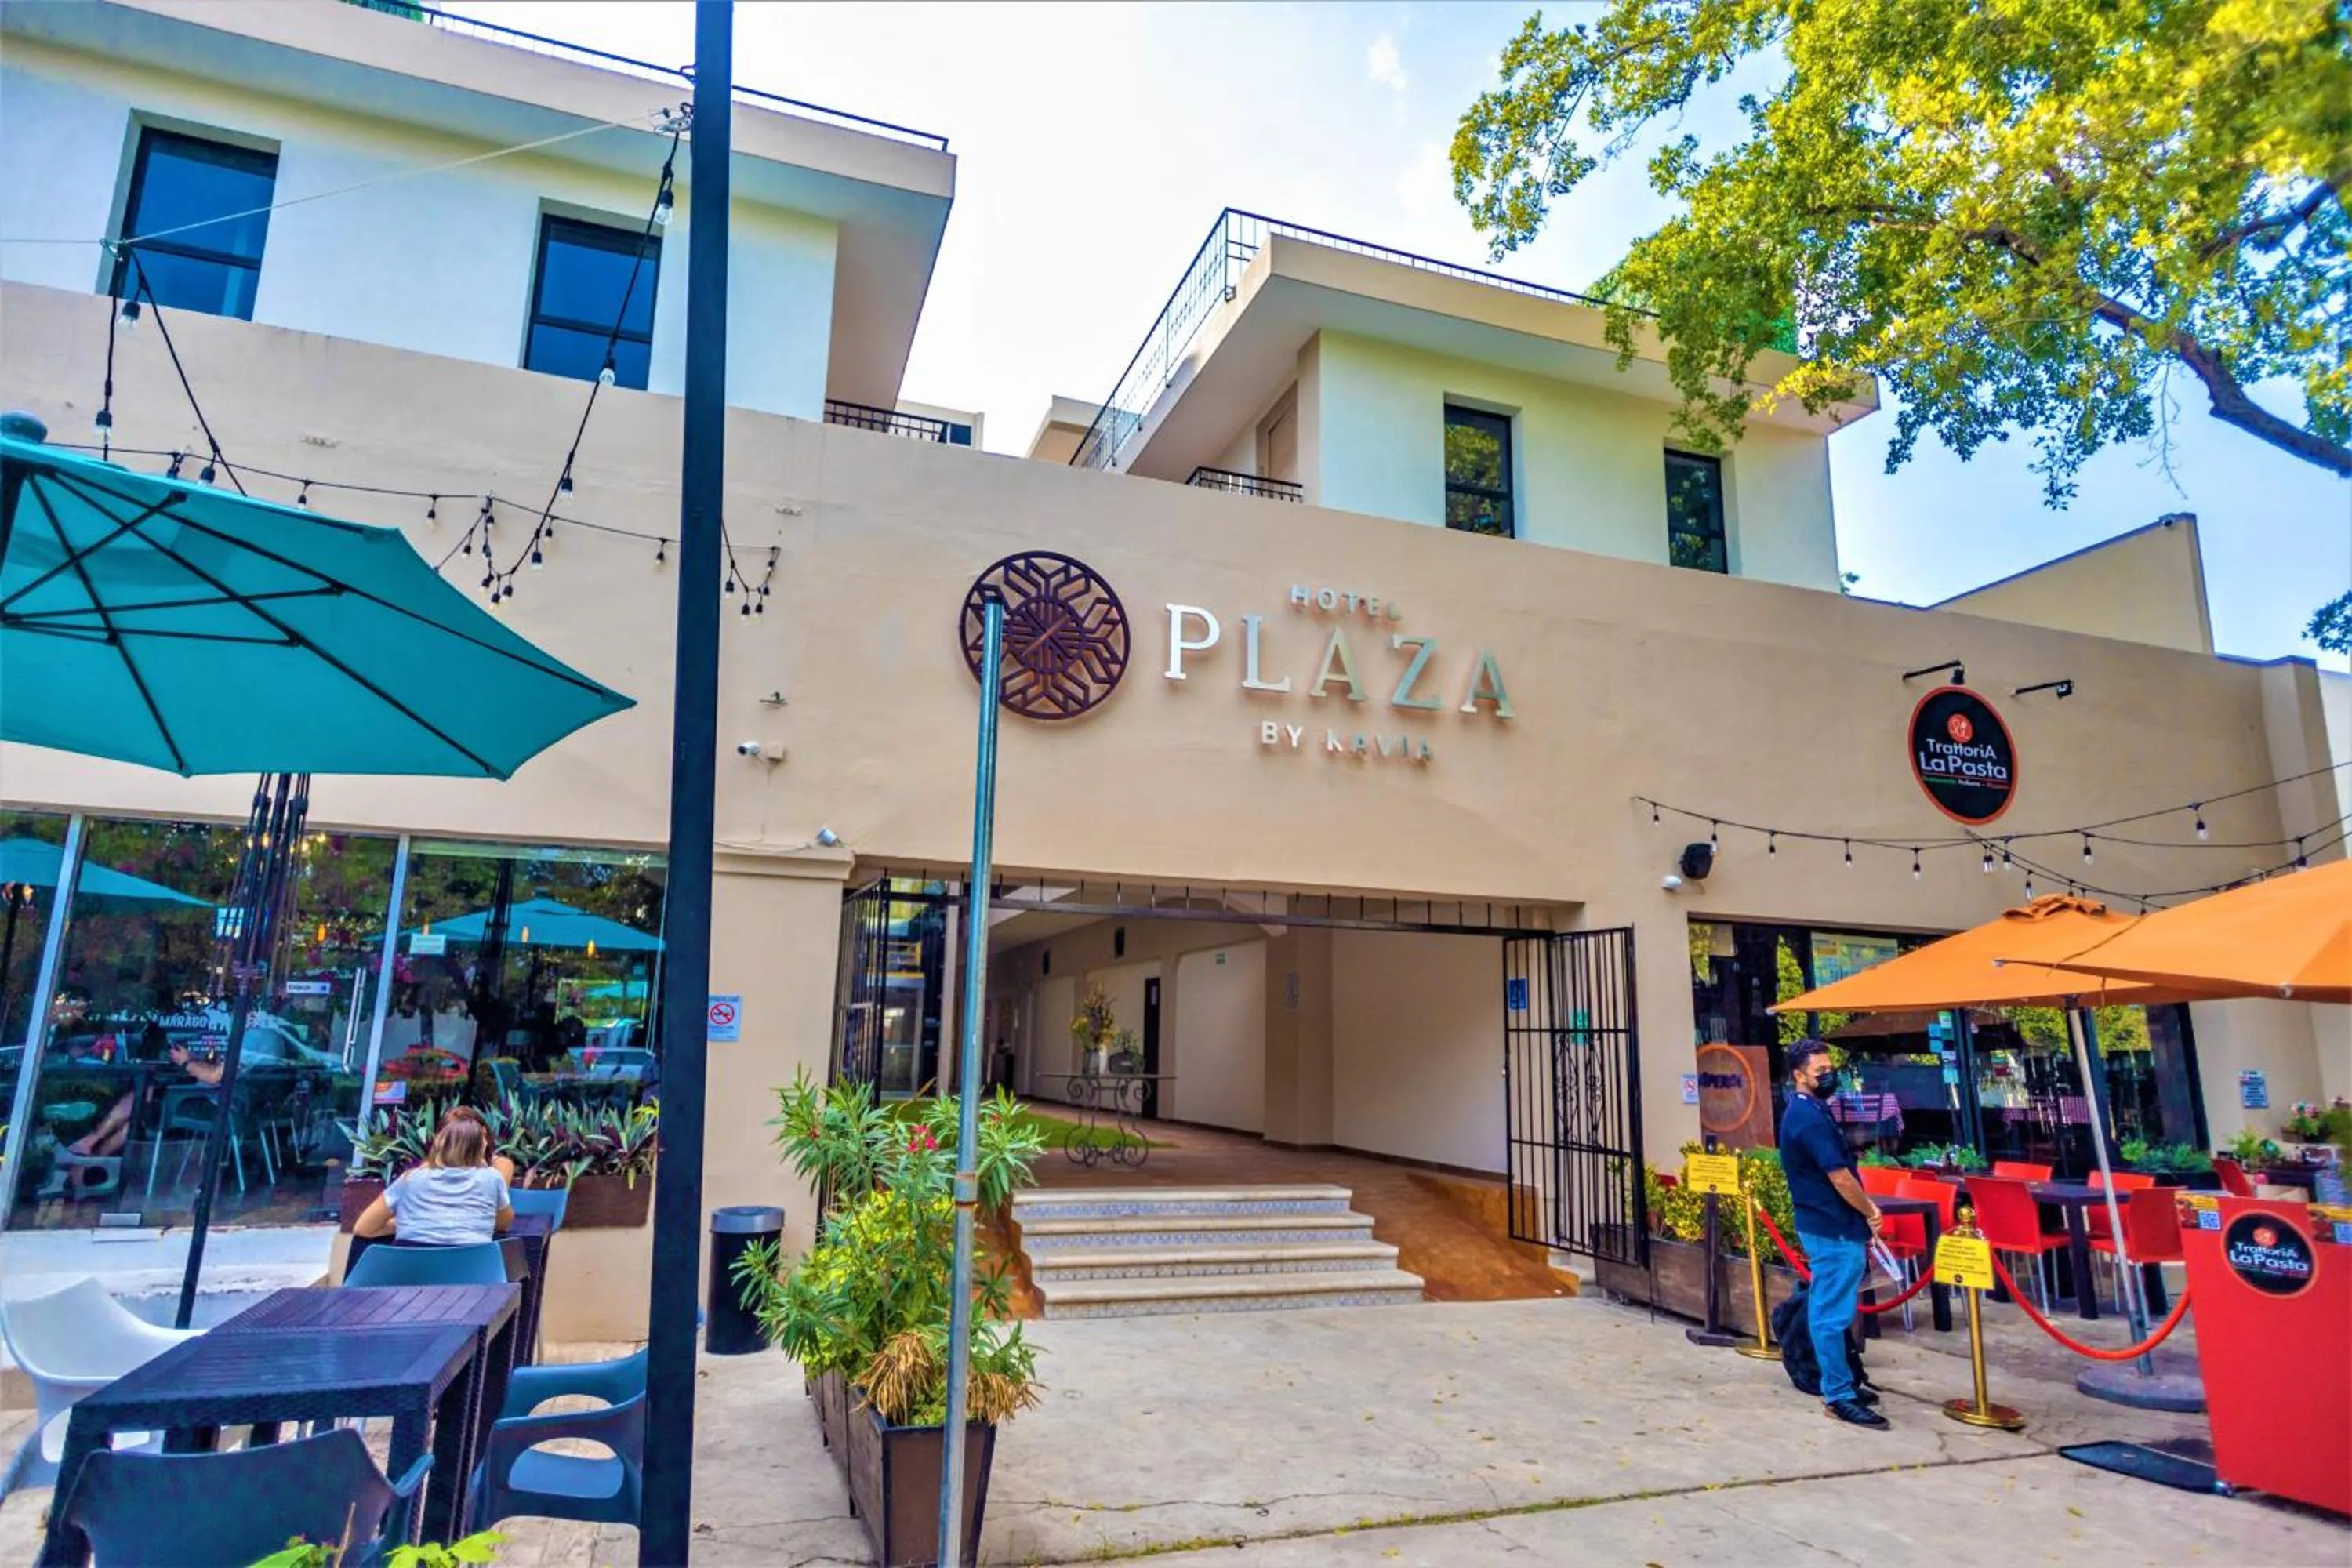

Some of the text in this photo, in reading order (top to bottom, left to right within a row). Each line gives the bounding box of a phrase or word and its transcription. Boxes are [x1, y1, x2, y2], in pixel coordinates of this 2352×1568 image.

[1290, 583, 1403, 621] HOTEL
[1163, 603, 1515, 718] PLAZA
[1260, 720, 1433, 761] BY KAVIA
